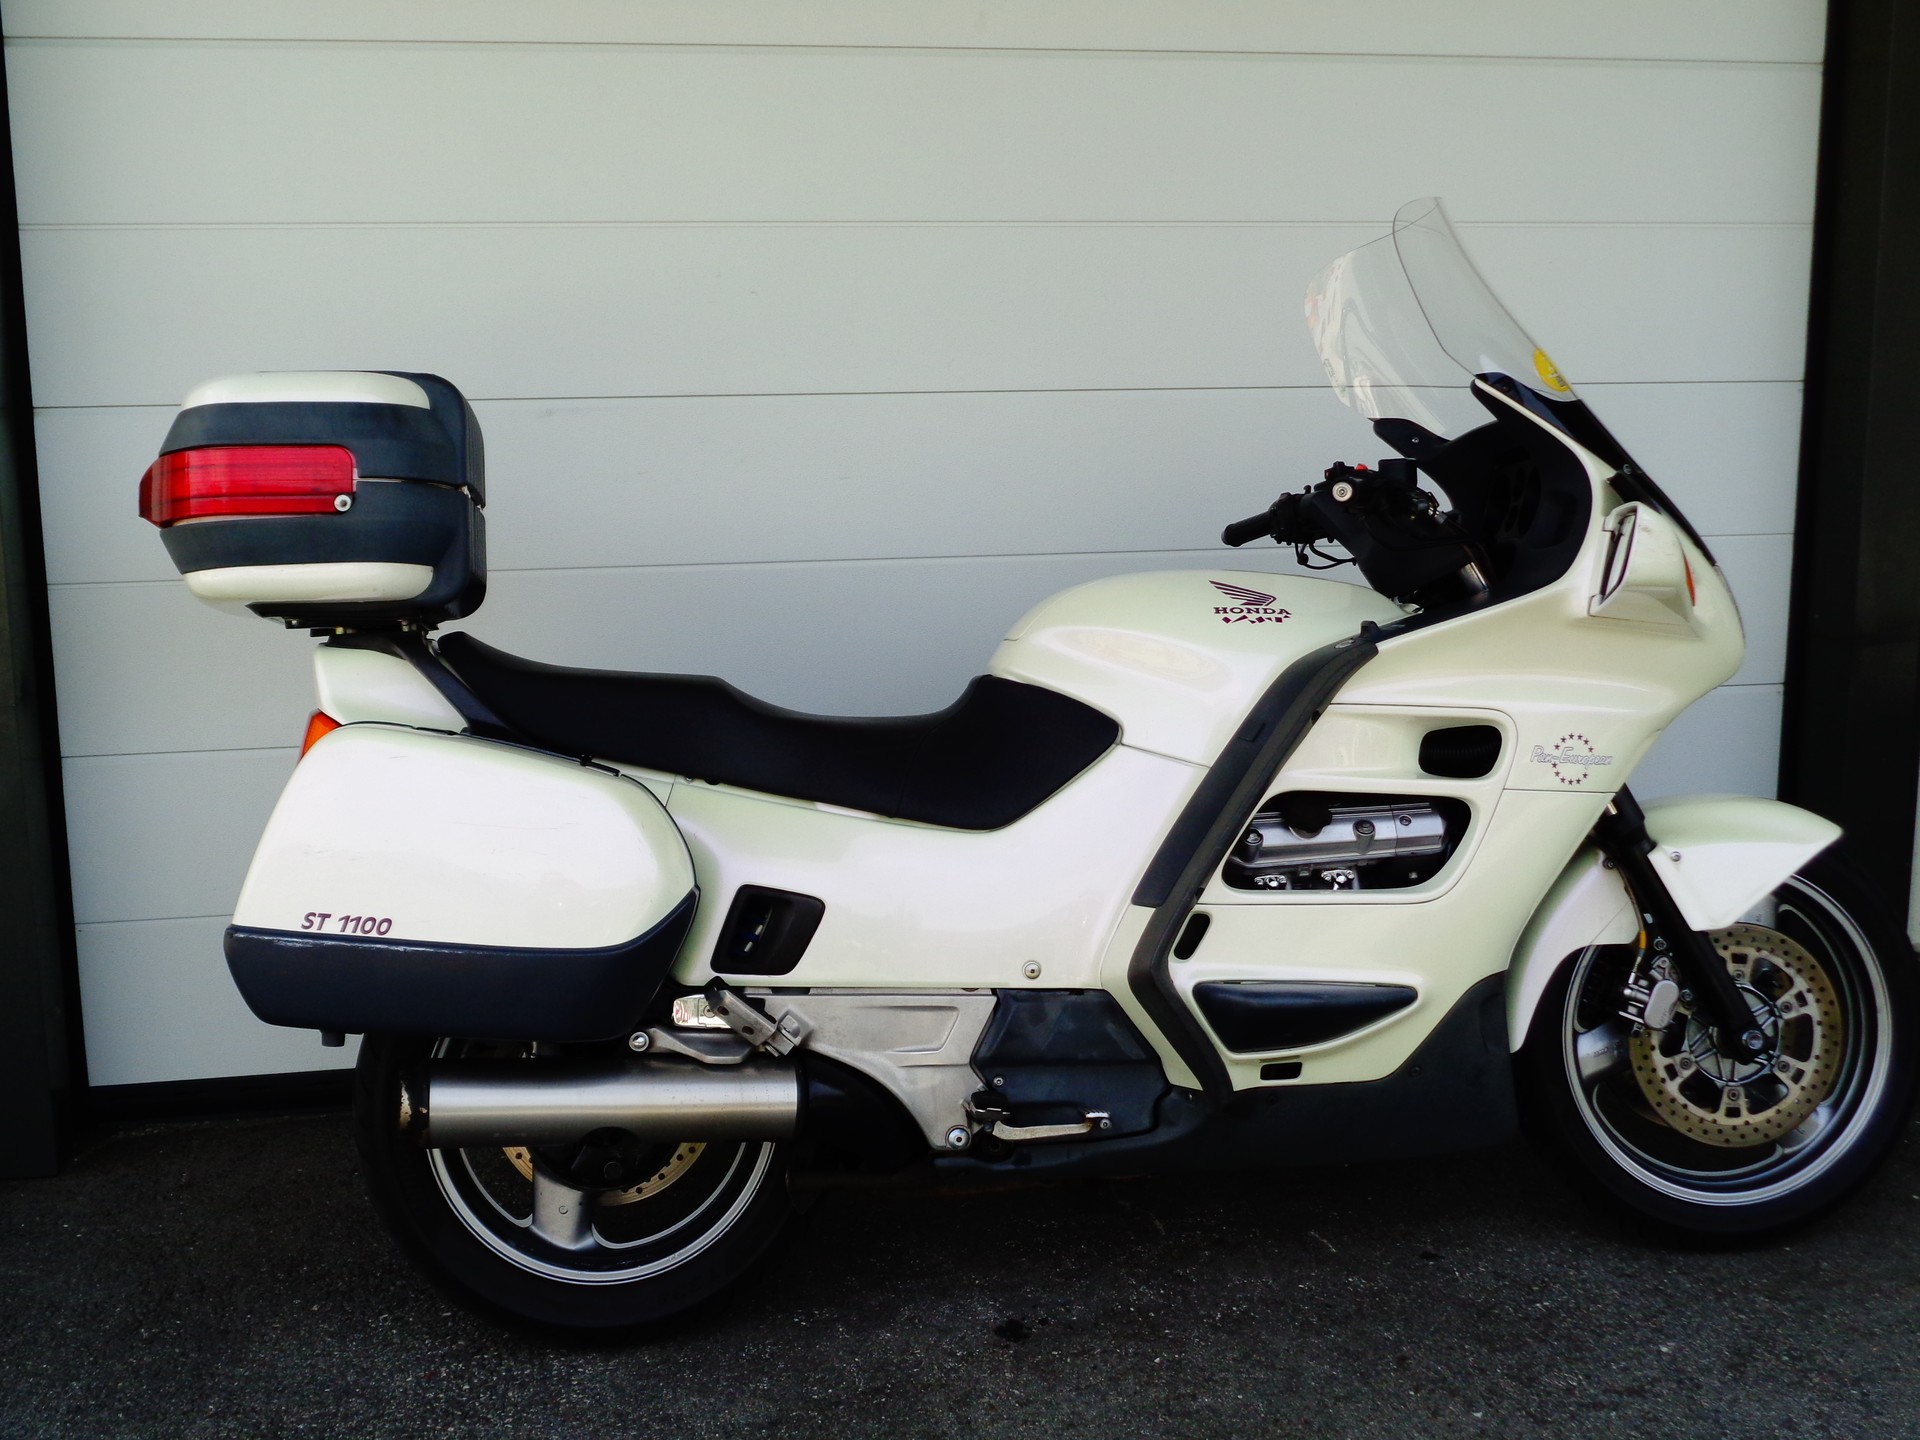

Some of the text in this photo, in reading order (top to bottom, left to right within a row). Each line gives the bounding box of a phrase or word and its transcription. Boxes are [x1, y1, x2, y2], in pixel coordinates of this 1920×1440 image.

[1213, 606, 1292, 615] HONDA
[301, 912, 393, 936] ST 1100
